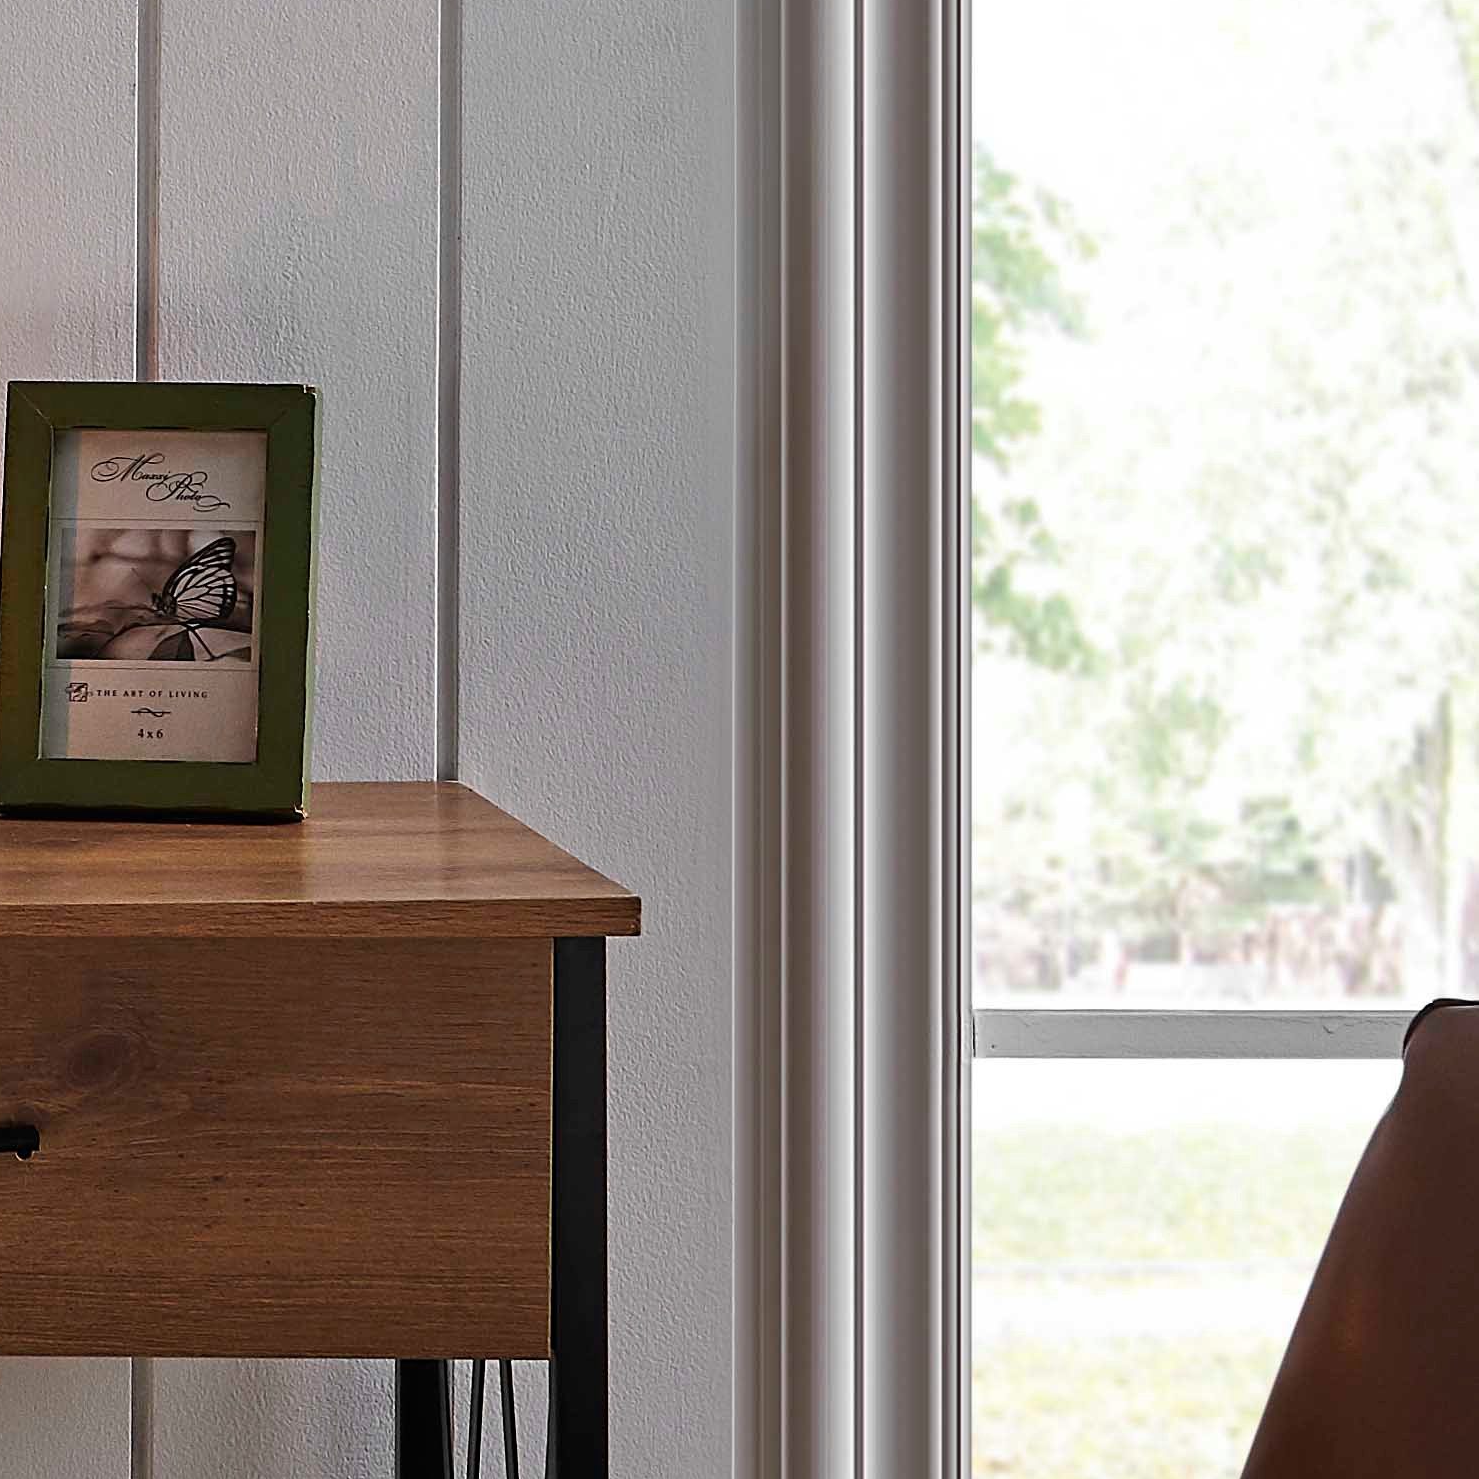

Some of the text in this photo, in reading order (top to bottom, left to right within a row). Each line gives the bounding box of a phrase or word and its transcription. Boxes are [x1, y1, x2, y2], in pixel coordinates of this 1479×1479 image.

[96, 689, 209, 699] THE ART OF LIVING
